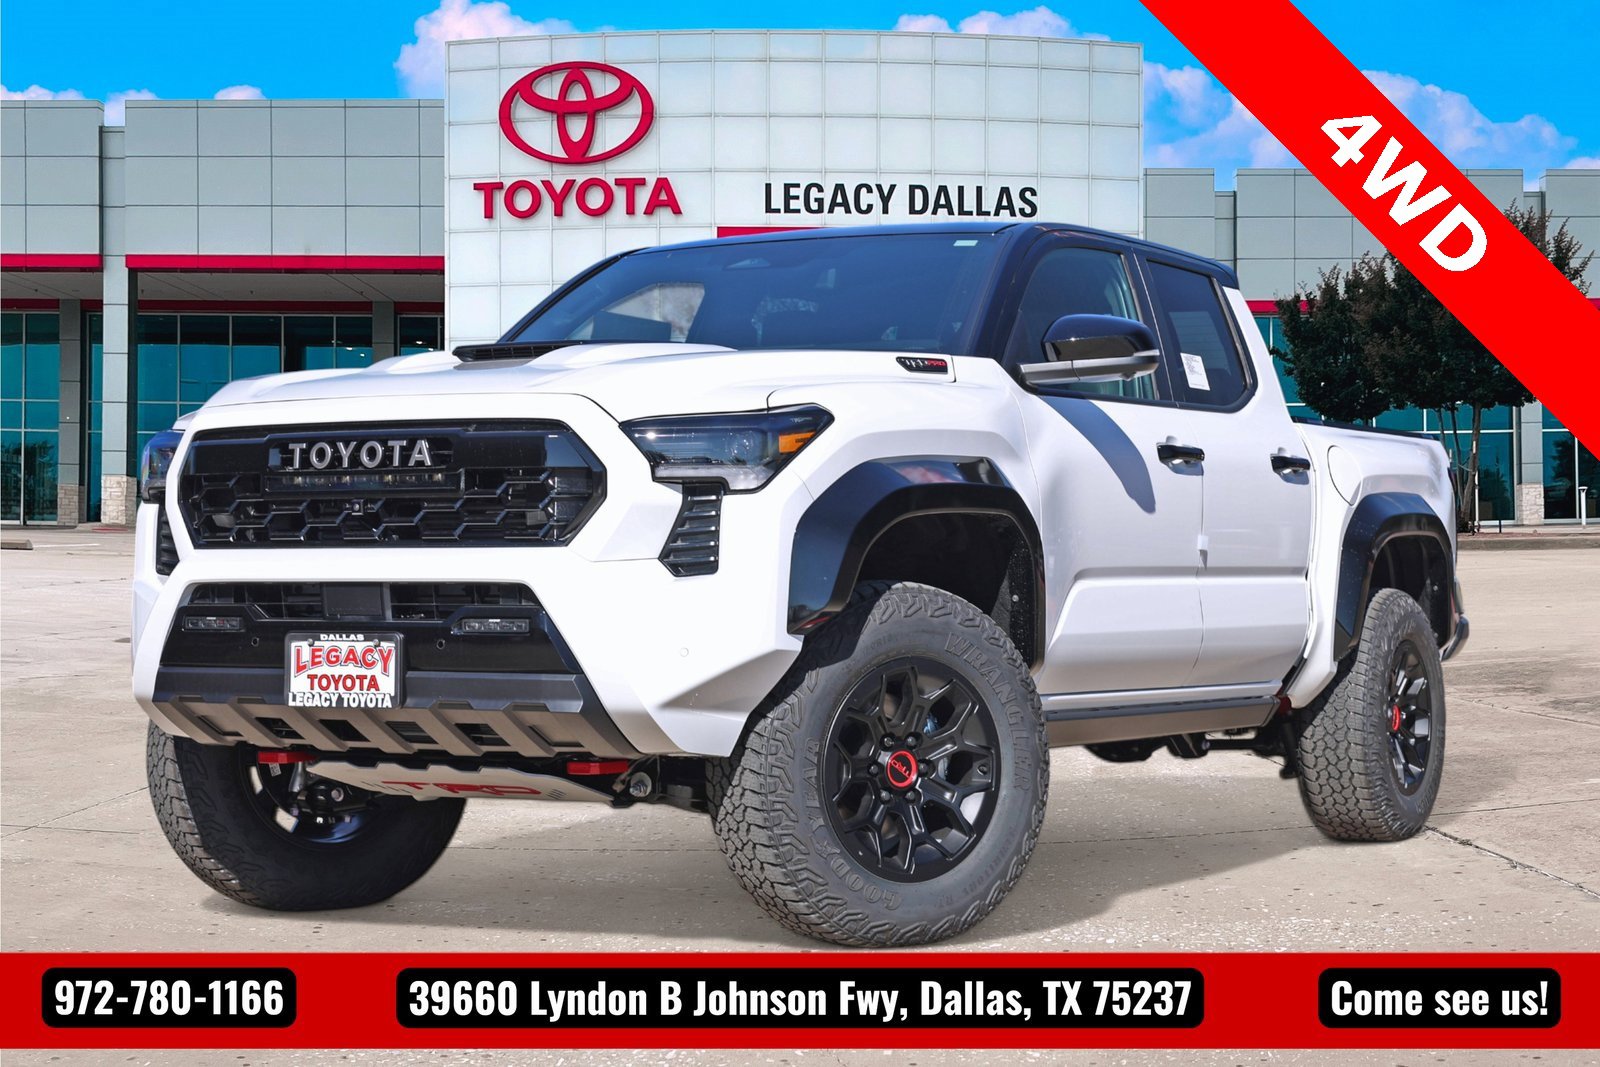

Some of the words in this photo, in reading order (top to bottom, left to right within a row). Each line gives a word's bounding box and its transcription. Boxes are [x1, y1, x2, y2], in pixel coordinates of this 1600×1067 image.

[473, 177, 683, 219] TOYOTA
[764, 182, 897, 215] LEGACY
[908, 184, 1038, 218] DALLAS
[288, 439, 432, 470] TOYOTA
[320, 633, 365, 641] DALLAS
[294, 645, 395, 678] LEGACY
[306, 673, 381, 692] TOYOTA
[288, 692, 340, 708] LEGACY
[341, 692, 393, 709] TOYOTA
[944, 630, 1035, 793] WRANGLER
